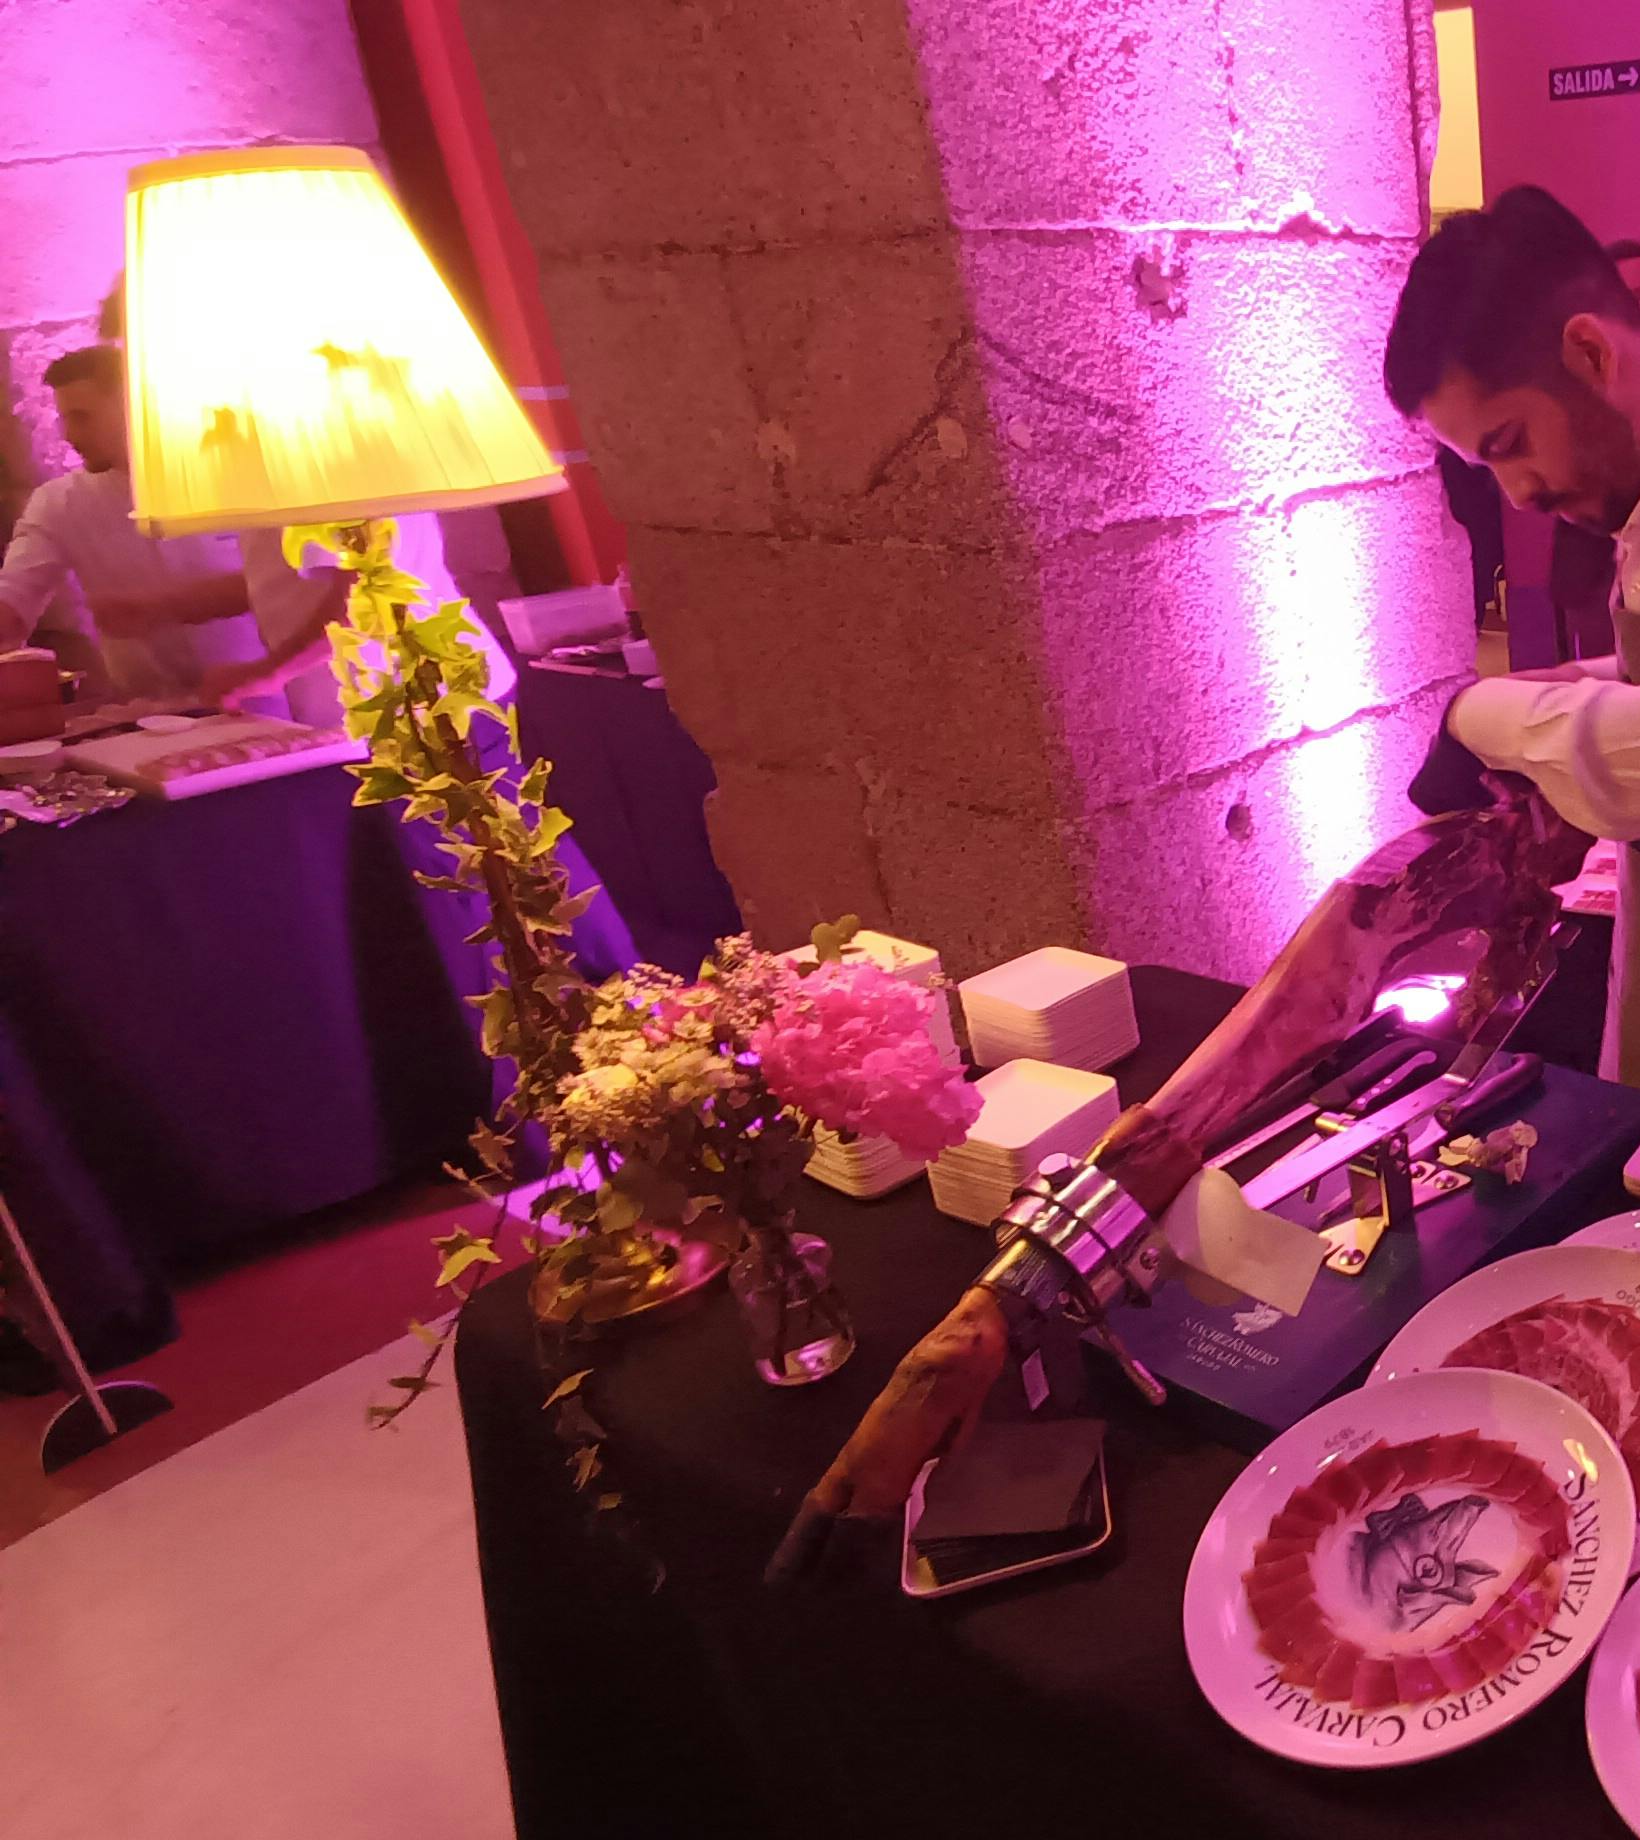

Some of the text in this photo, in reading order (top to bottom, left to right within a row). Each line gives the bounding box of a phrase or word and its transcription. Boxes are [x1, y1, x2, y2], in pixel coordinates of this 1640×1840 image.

[1553, 68, 1615, 95] SALIDA
[1254, 1473, 1600, 1747] SANCHEZ ROMERO CARVAJAL
